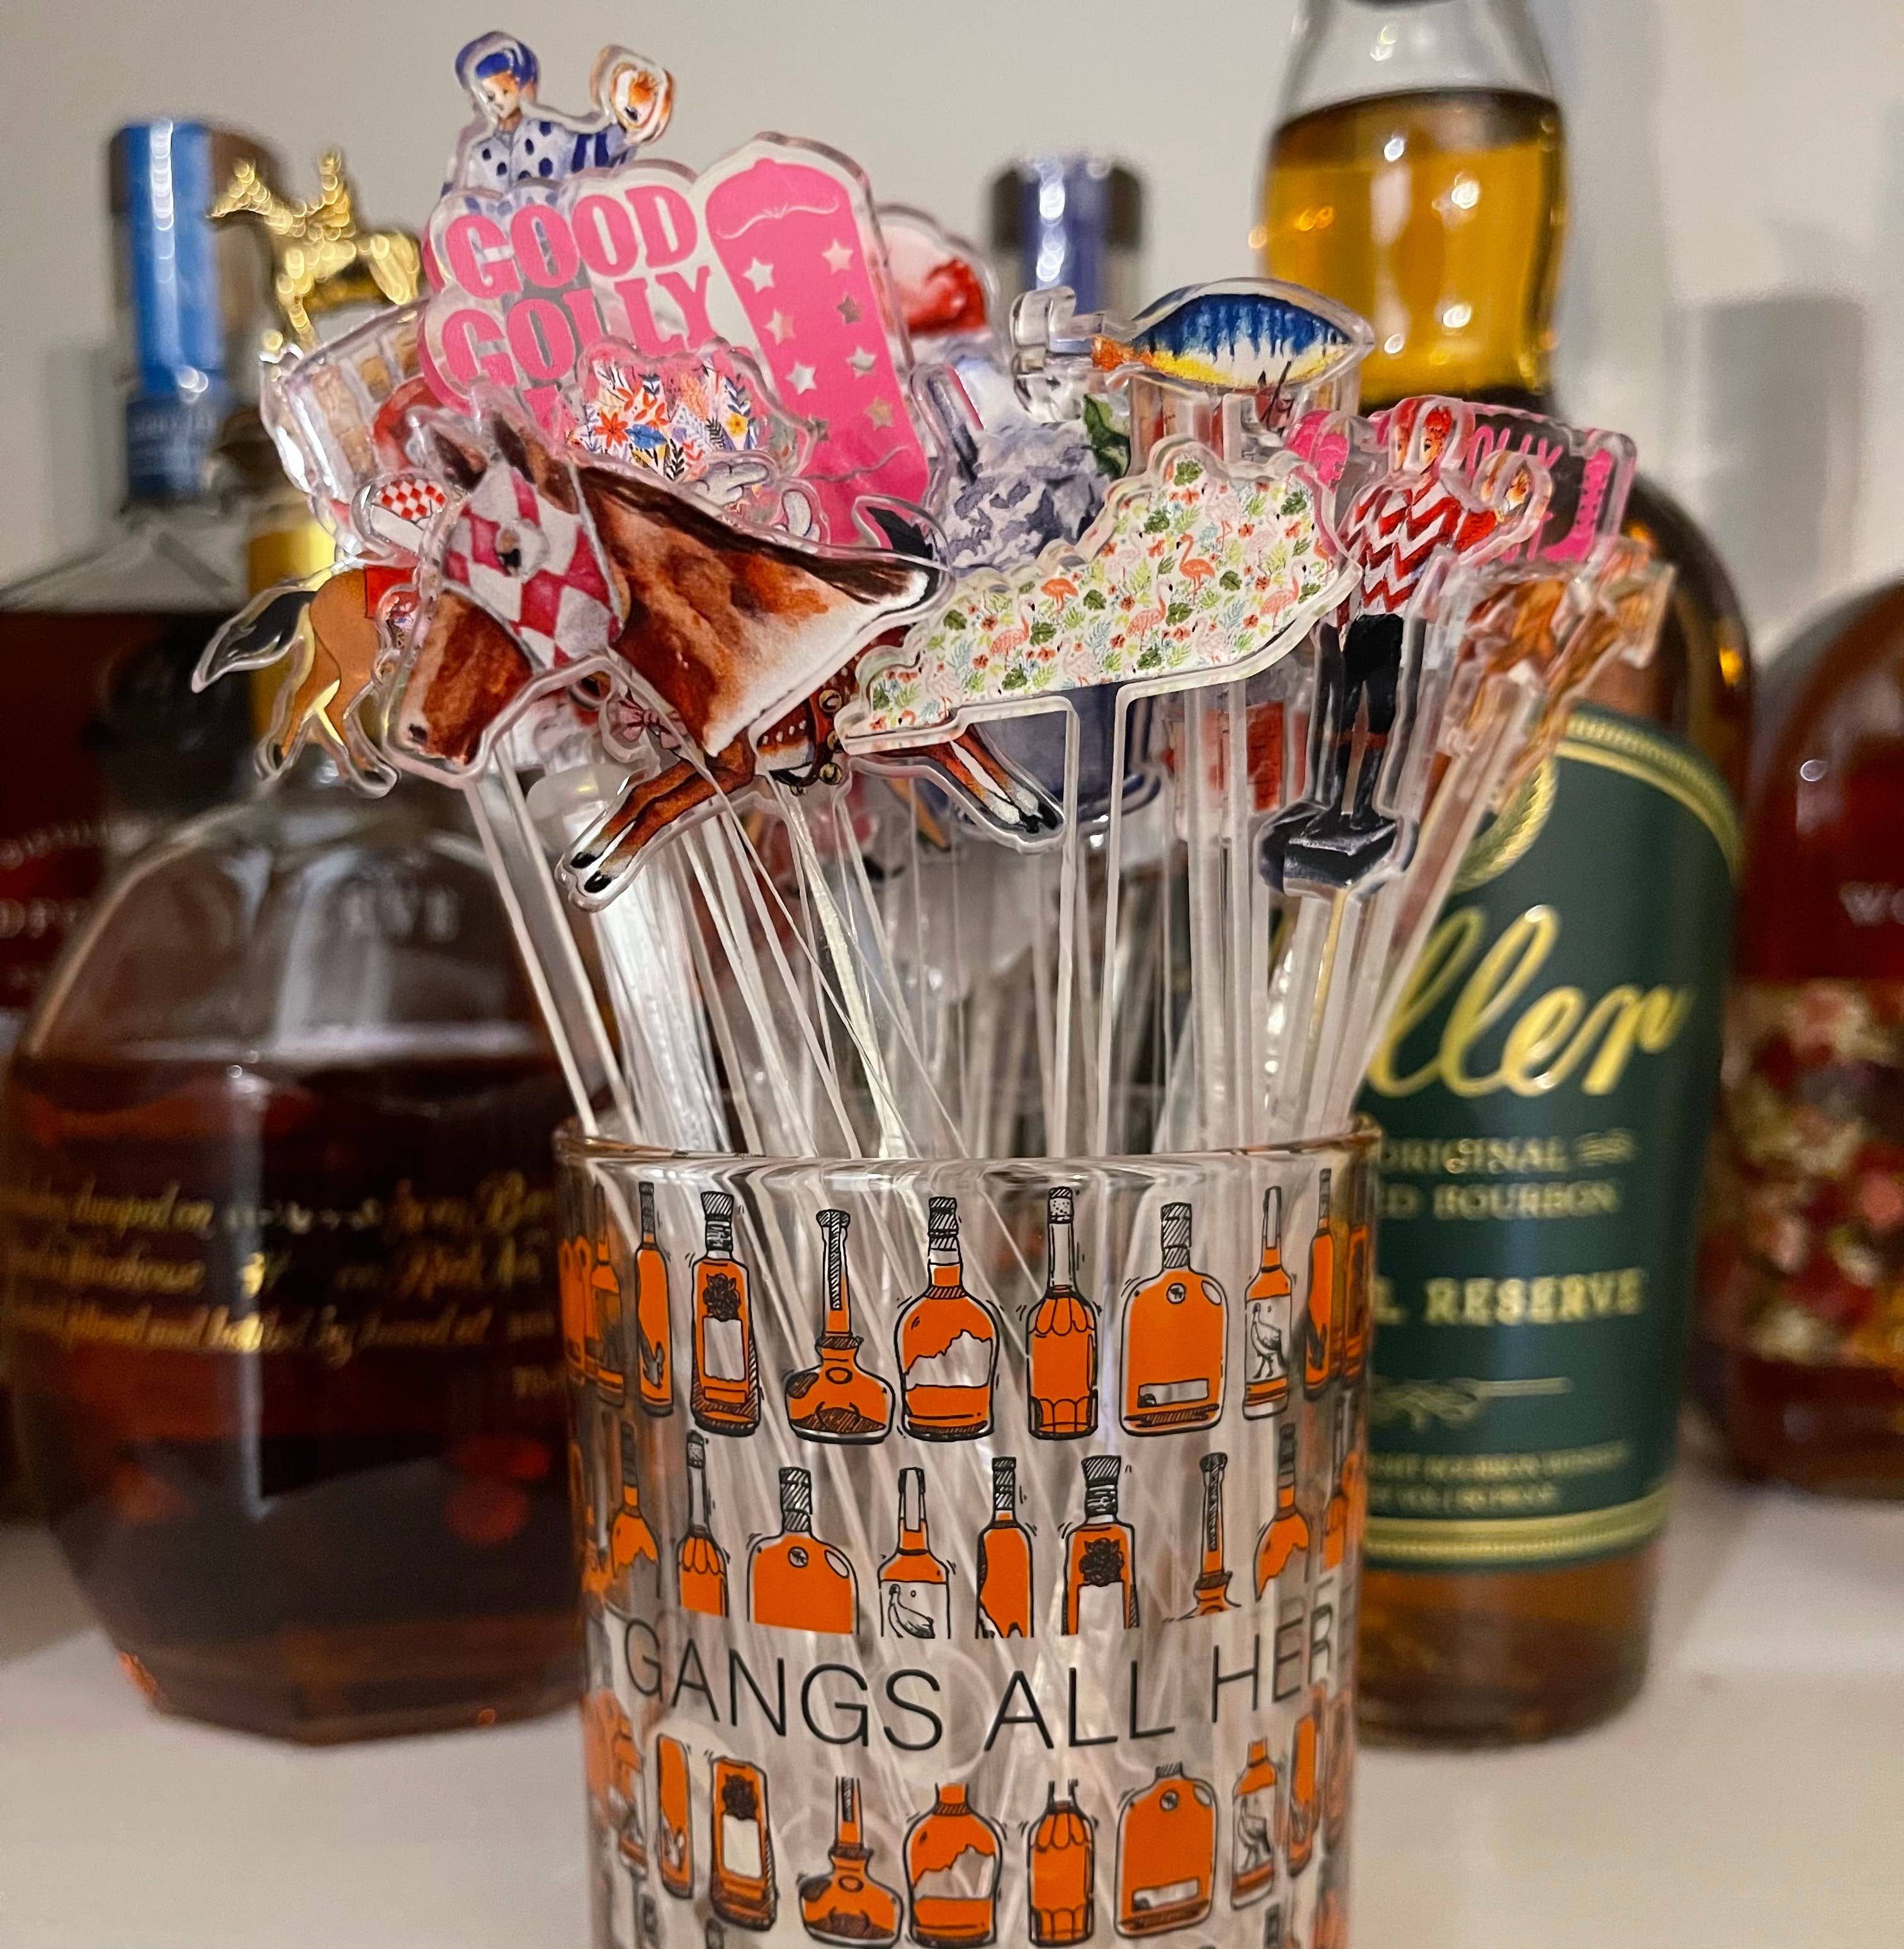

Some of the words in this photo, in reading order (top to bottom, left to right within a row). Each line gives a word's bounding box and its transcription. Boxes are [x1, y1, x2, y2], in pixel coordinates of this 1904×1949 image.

[445, 185, 698, 300] GOOD
[441, 264, 714, 388] GOLLY
[1365, 904, 1696, 1097] ller
[1433, 1181, 1621, 1221] BOURBON
[1424, 1267, 1645, 1326] RESERVE
[624, 1618, 943, 1751] GANGS
[983, 1660, 1176, 1753] ALL
[1211, 1602, 1347, 1723] HER
